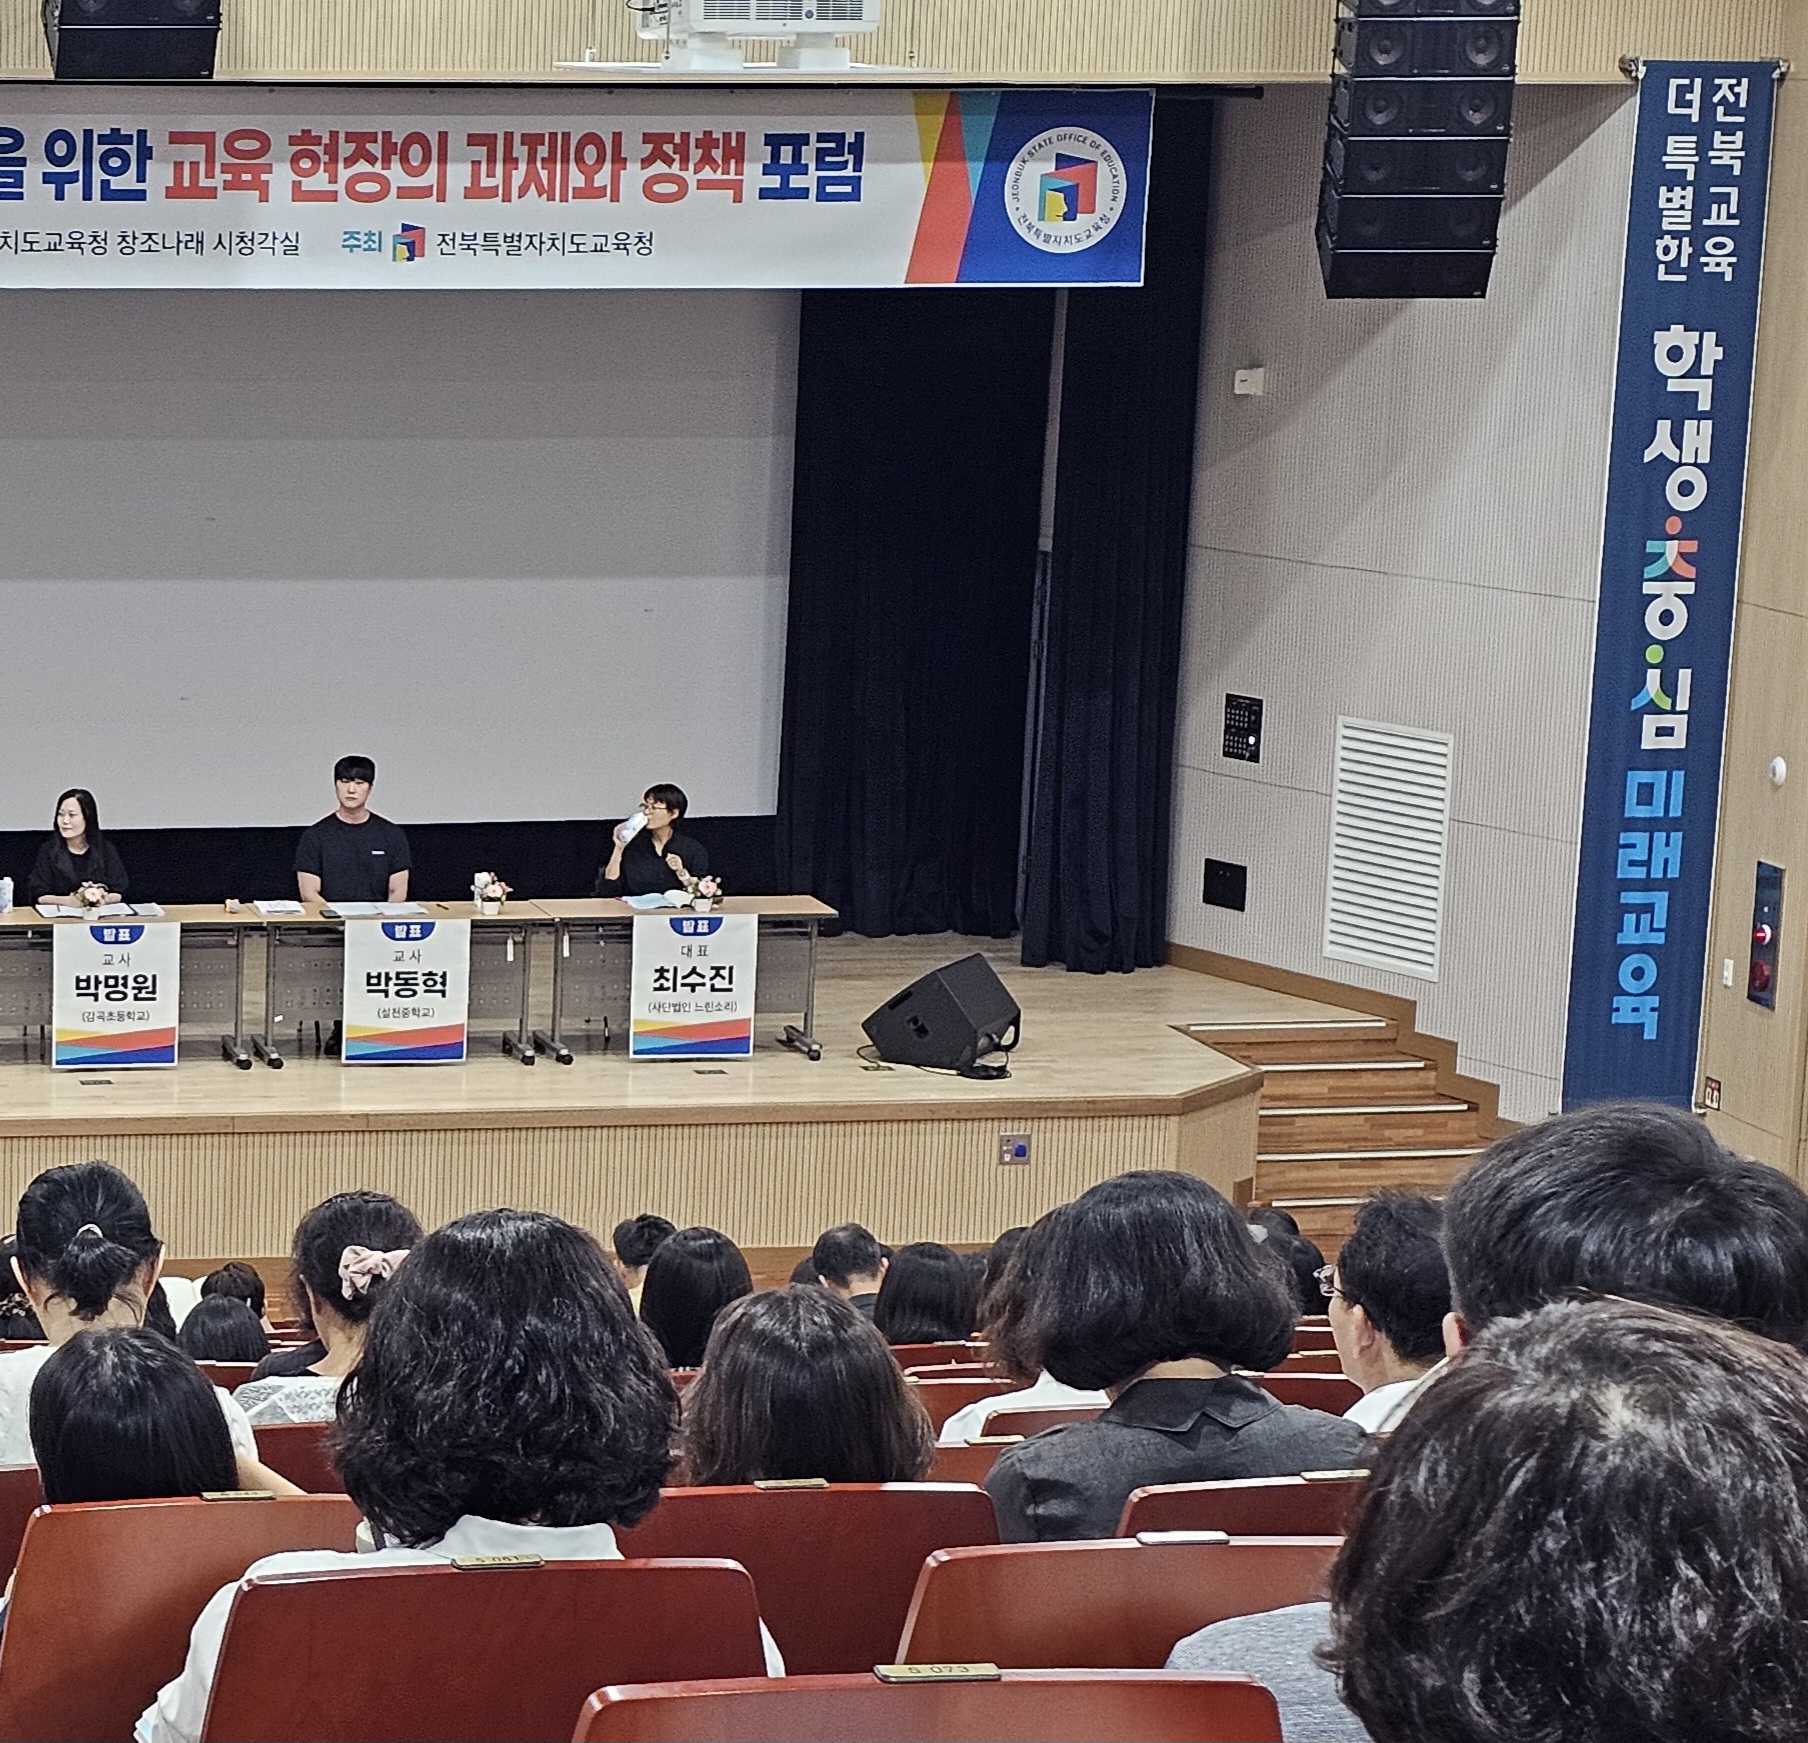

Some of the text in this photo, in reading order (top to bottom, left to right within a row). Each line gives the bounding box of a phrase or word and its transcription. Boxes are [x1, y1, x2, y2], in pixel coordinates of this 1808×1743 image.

[42, 127, 154, 202] 위한
[165, 128, 273, 204] 교육
[288, 128, 449, 204] 현장의
[463, 130, 628, 204] 과제와
[640, 130, 747, 204] 정책
[758, 130, 866, 203] 포럼
[1011, 133, 1121, 203] JEONBUK STATE OFFICE OF EDUCATION
[1654, 77, 1702, 283] 더 특별한
[1699, 77, 1749, 283] 전북교육
[116, 230, 206, 257] 창조나래
[212, 231, 301, 257] 시청각실
[341, 230, 655, 257] 주최 전북특별자치도교육청
[1016, 212, 1112, 247] 전북특별자치도교육청
[1611, 769, 1686, 1041] 미래교육
[74, 973, 158, 1003] 박명원
[365, 970, 448, 999] 박동혁
[652, 965, 734, 994] 최수진
